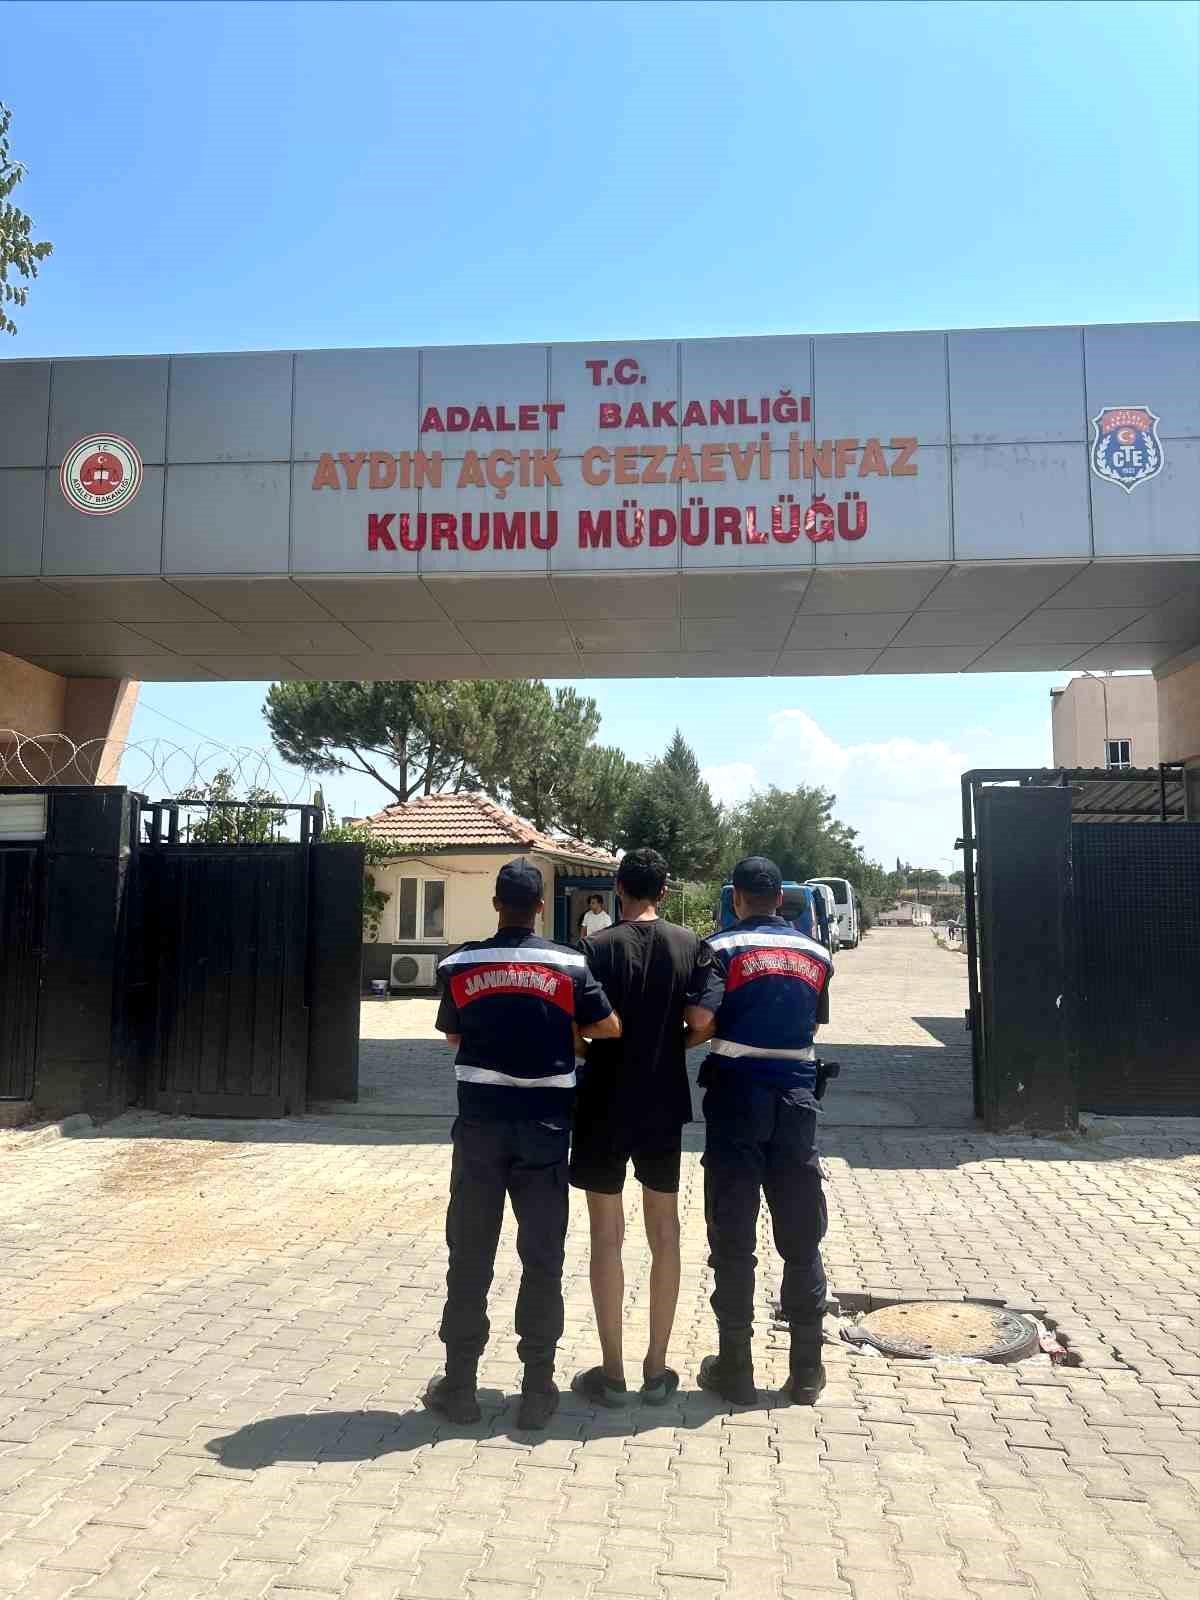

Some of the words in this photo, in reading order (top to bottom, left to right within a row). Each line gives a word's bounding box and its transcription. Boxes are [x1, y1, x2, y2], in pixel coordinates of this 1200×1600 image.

[584, 358, 647, 387] T.C.
[420, 403, 566, 433] ADALET
[599, 389, 812, 429] BAKANLIĞI
[312, 450, 443, 490] AYDIN
[457, 448, 563, 500] AÇIK
[581, 431, 773, 487] CEZAEVİ
[788, 431, 919, 481] İNFAZ
[1113, 445, 1143, 467] CTE
[367, 510, 559, 551] KURUMU
[578, 491, 868, 549] MÜDÜRLÜĞÜ
